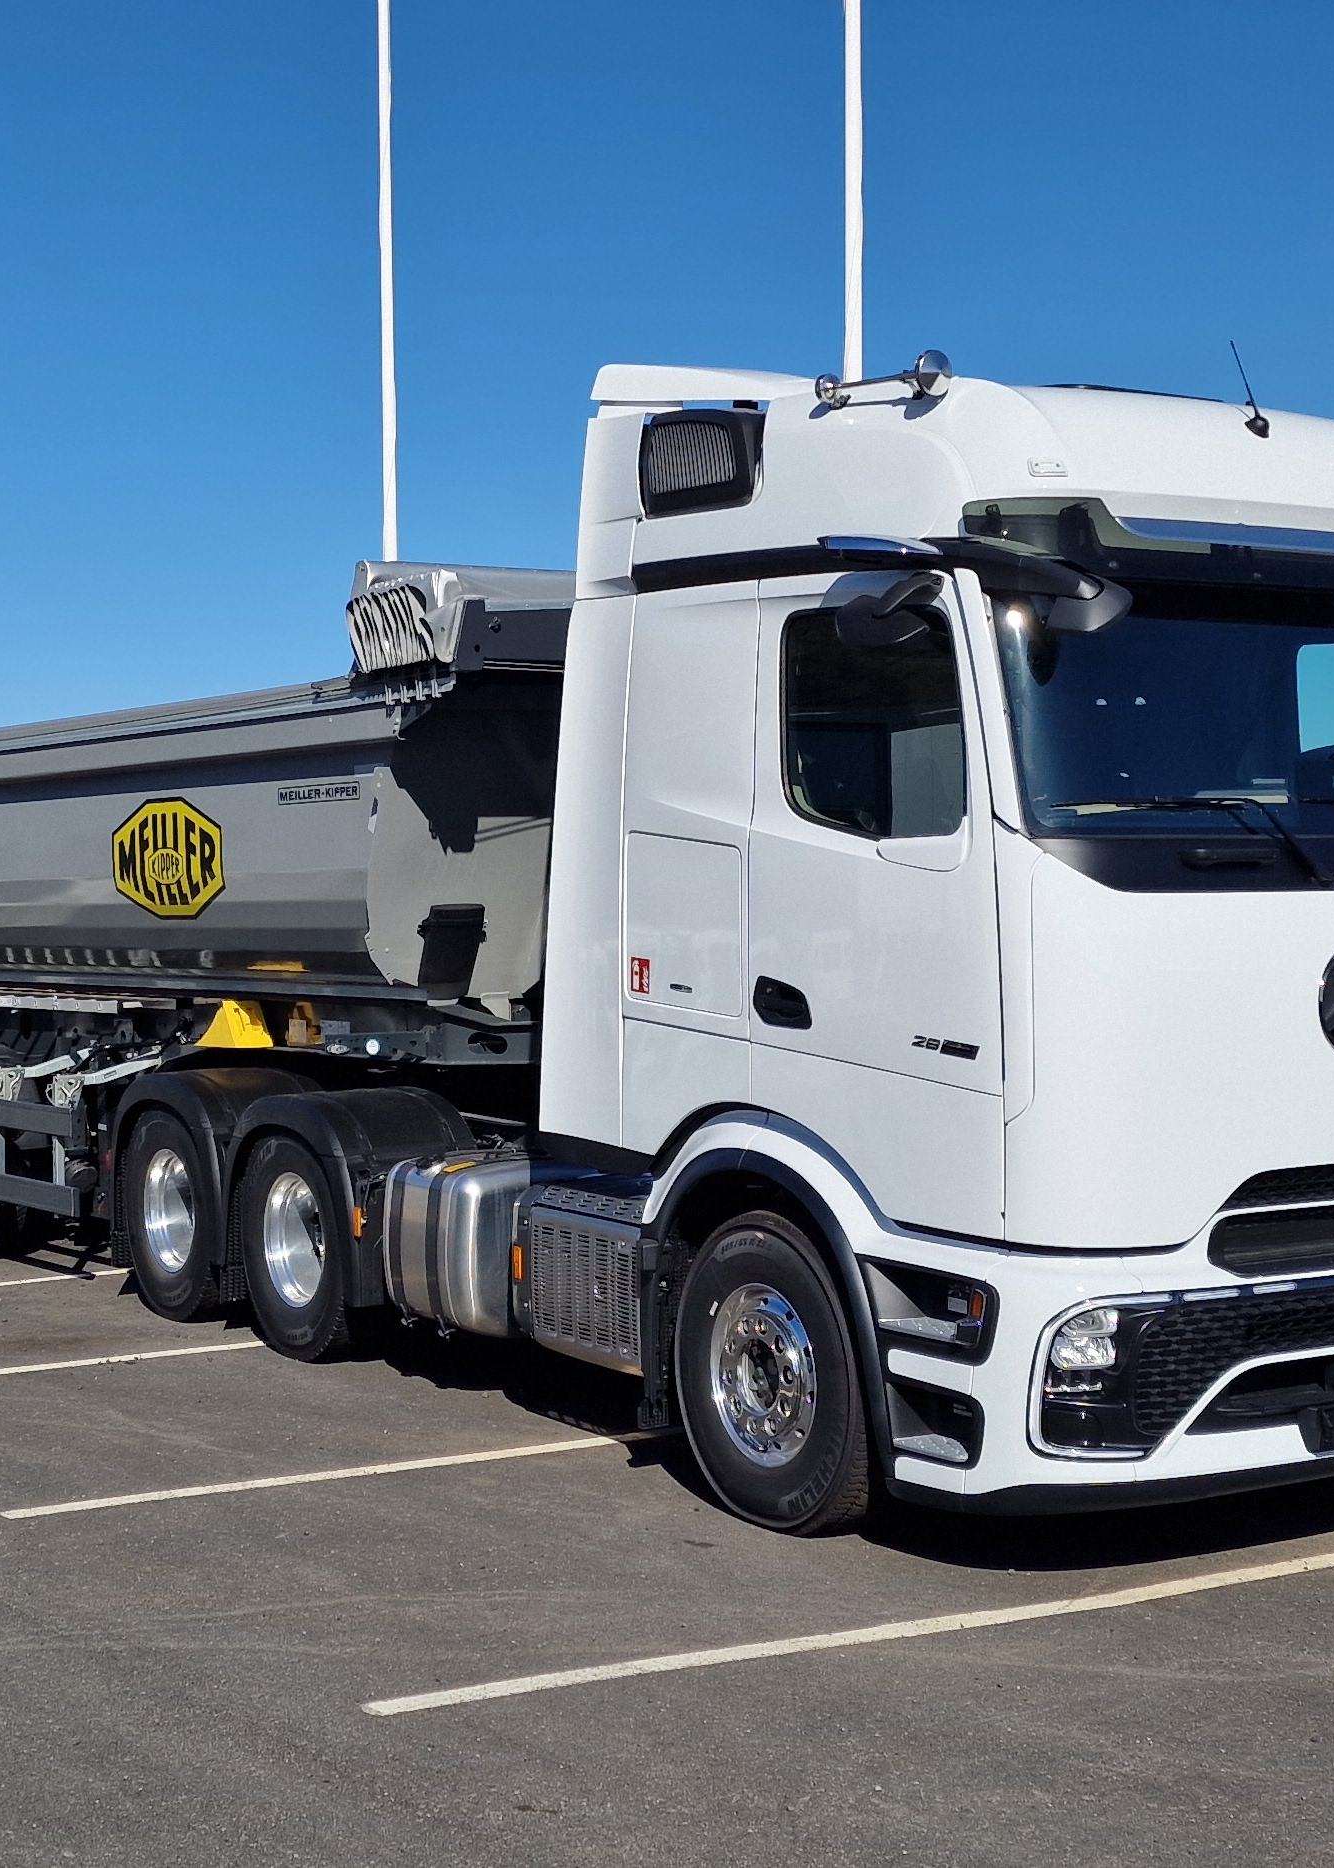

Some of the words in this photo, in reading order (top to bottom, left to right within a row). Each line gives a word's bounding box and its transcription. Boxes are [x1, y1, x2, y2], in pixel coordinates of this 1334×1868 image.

[279, 785, 358, 802] MEILLER-KIPPER
[118, 811, 217, 906] MEILLER
[152, 852, 180, 881] KIPPER
